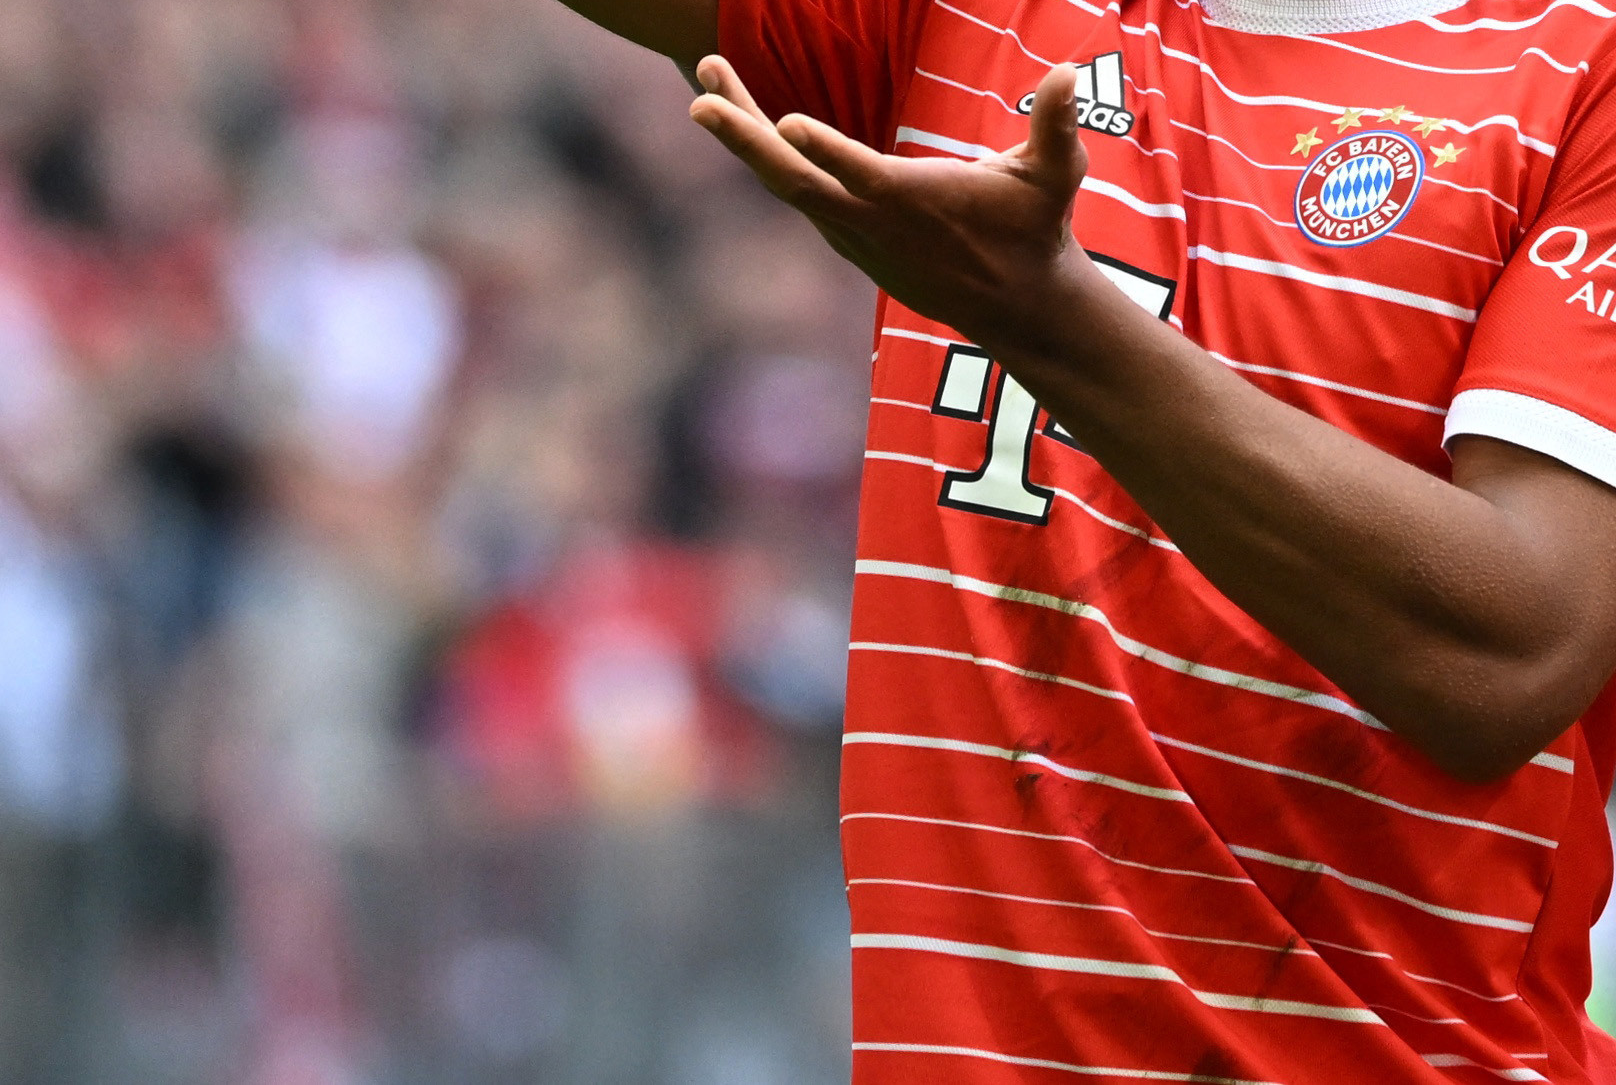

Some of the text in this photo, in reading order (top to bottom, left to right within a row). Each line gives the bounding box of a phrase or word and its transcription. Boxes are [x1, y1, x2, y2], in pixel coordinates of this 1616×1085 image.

[1312, 137, 1414, 181] FC BAYERN
[1301, 195, 1401, 239] MÜNCHEN
